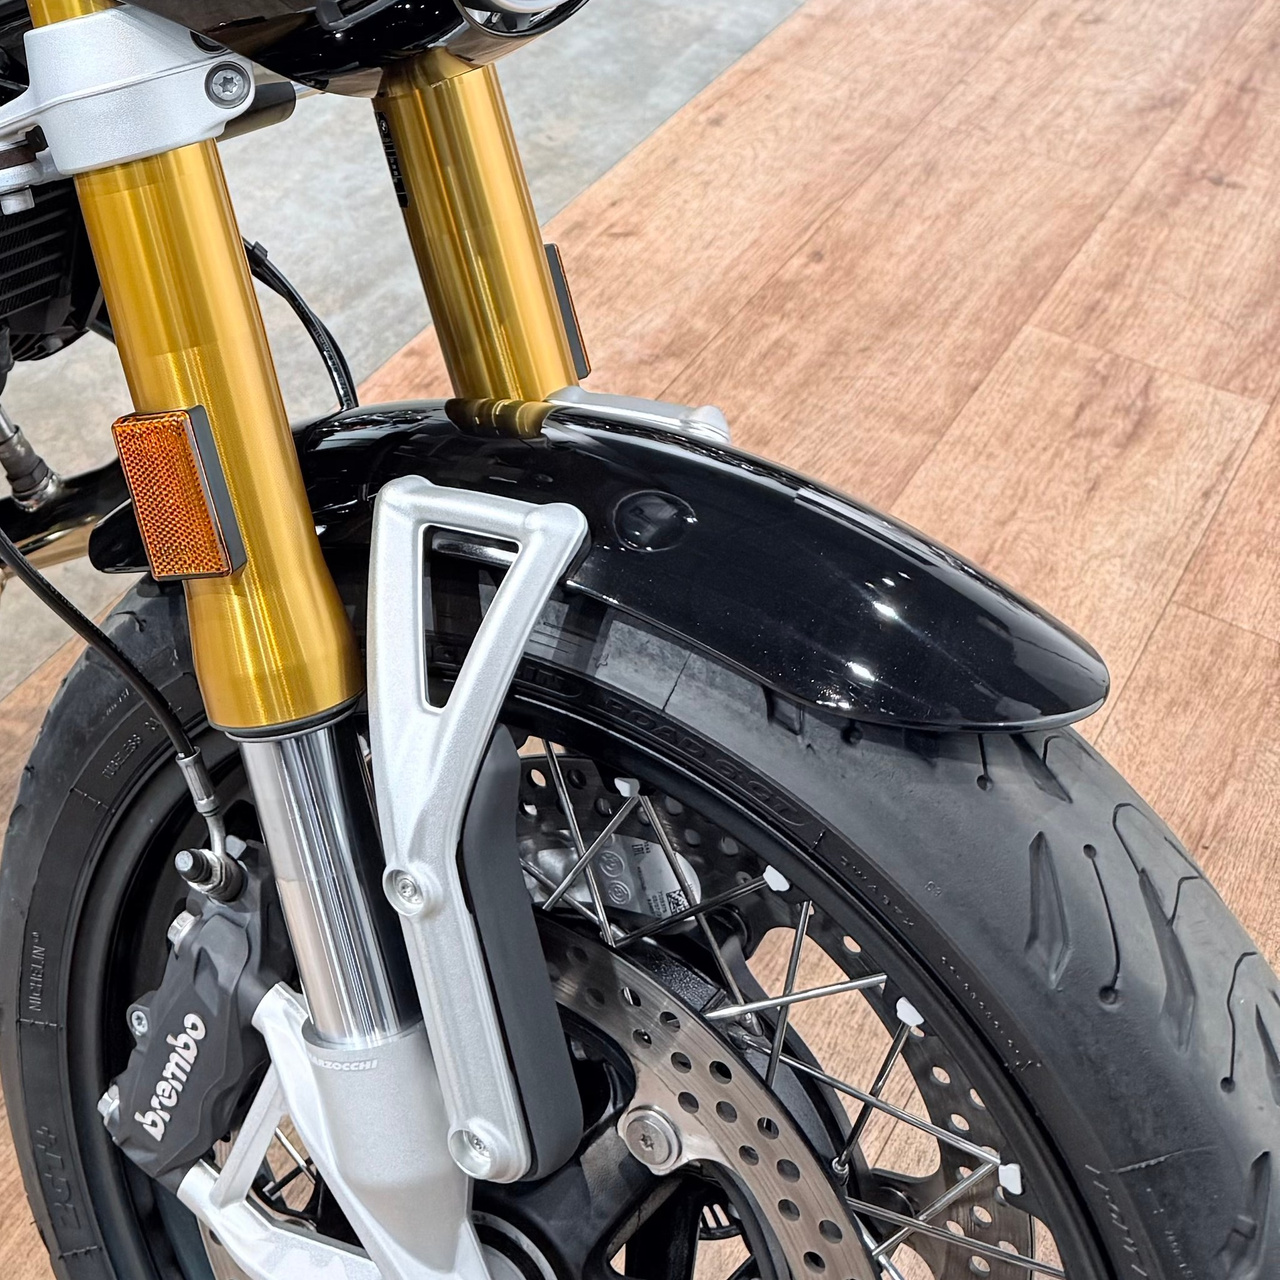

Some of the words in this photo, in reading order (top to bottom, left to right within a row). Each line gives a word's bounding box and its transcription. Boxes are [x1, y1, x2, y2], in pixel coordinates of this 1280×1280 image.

[604, 696, 706, 760] ROAD
[29, 945, 45, 1011] MICHELIN
[134, 1013, 206, 1142] brembo
